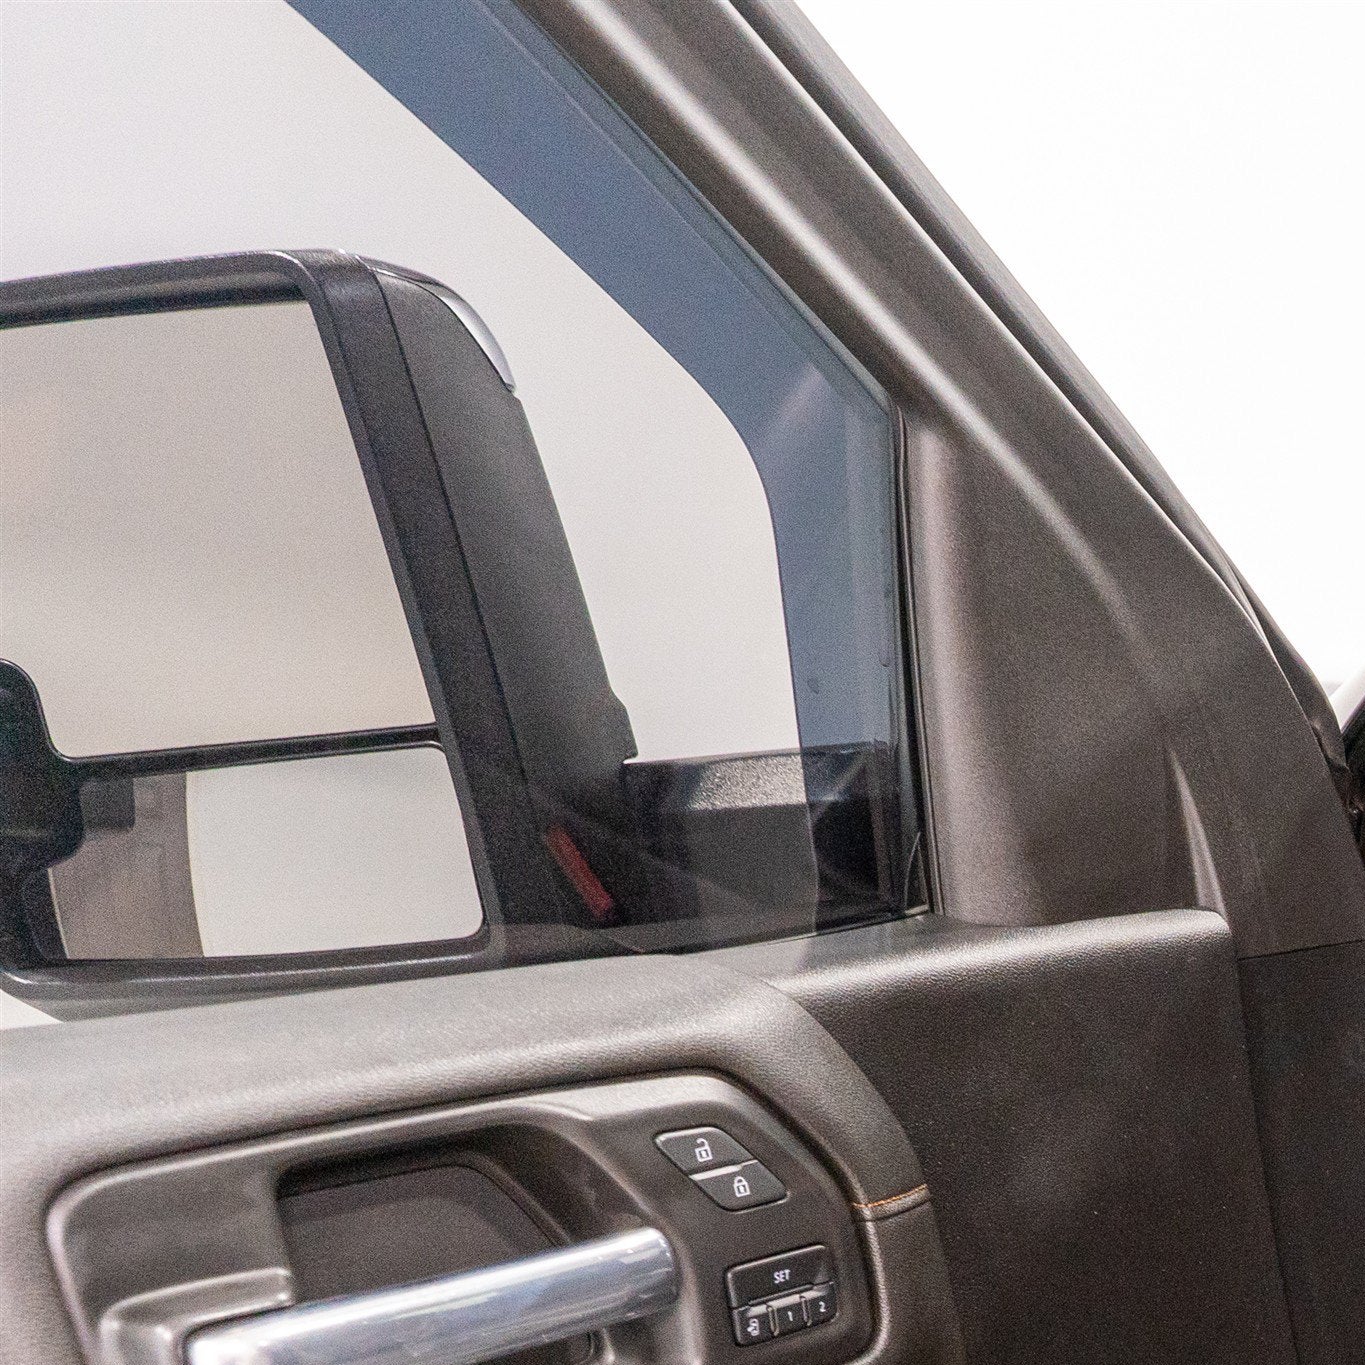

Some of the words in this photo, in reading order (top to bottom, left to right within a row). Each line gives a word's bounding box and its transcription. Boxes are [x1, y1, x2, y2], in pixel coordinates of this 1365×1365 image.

[773, 1269, 790, 1284] SET
[818, 1301, 827, 1313] 2
[787, 1310, 793, 1322] 1
